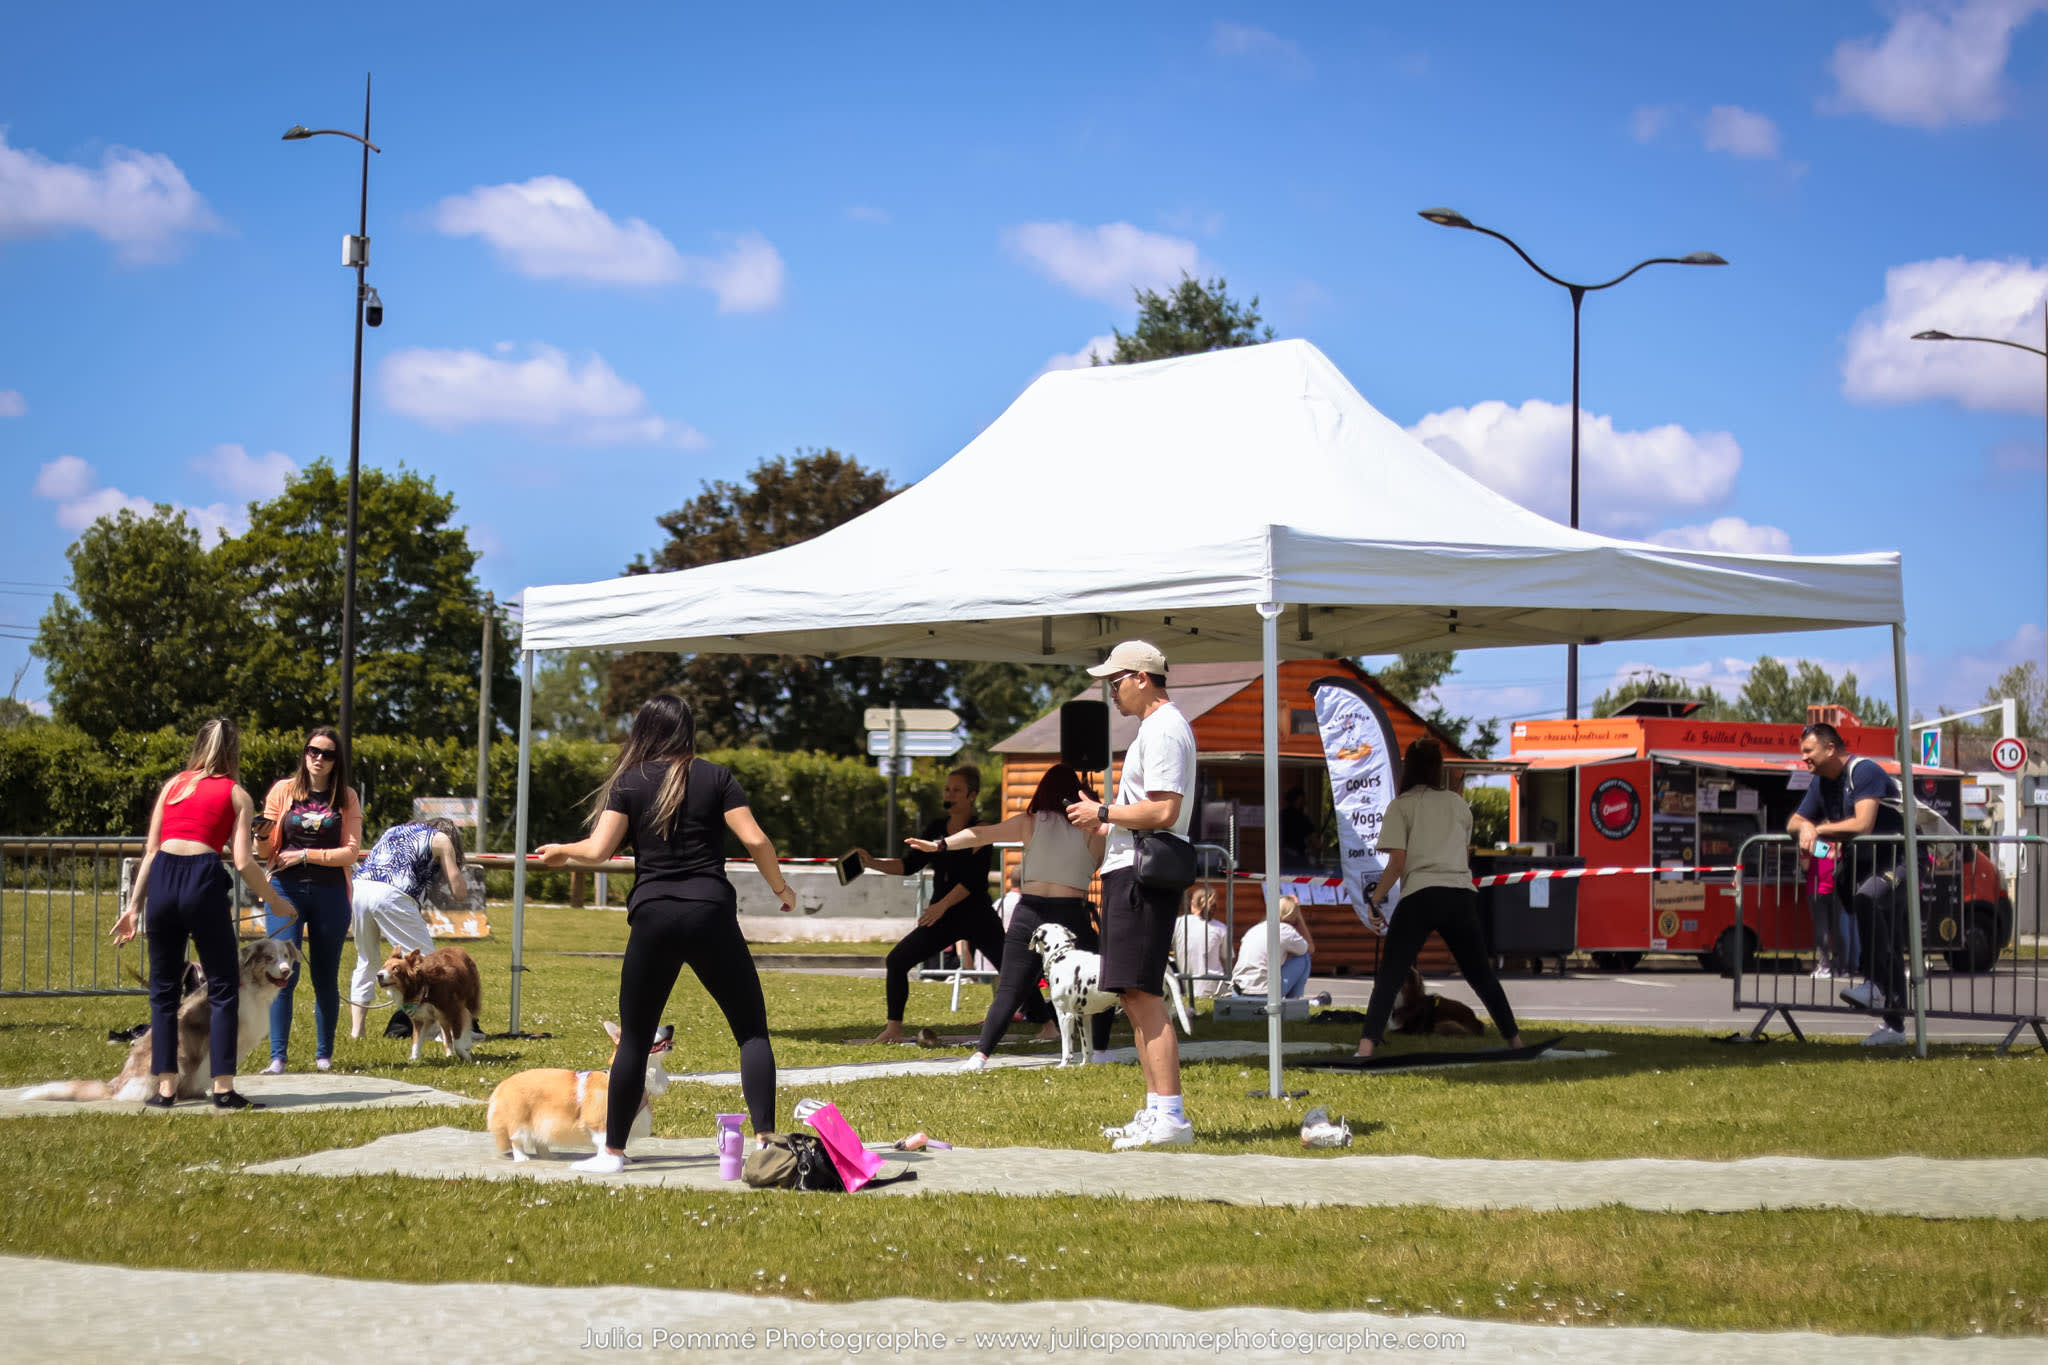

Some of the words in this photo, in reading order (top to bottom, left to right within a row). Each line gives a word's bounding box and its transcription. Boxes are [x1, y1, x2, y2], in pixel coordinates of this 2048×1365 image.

[2000, 748, 2018, 761] 10
[1346, 776, 1381, 791] Cours
[1361, 796, 1371, 804] de
[1352, 812, 1383, 828] Yoga
[1348, 849, 1365, 858] son
